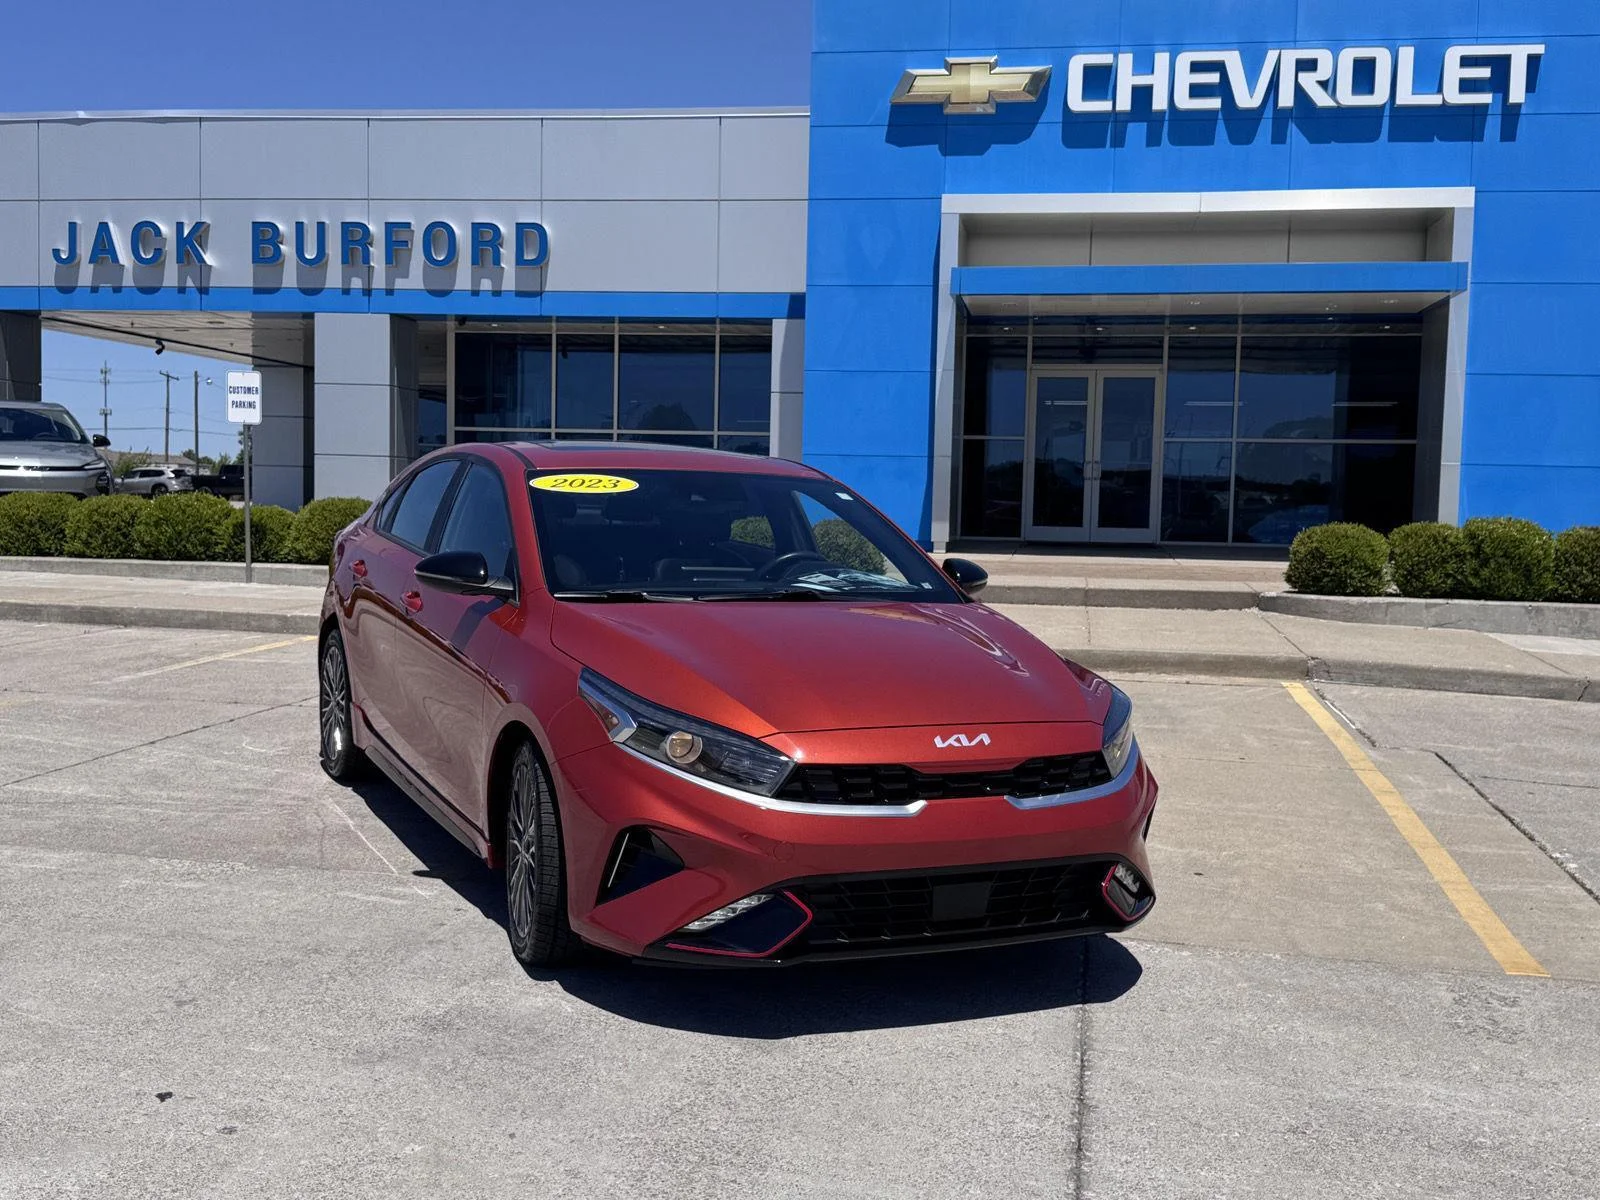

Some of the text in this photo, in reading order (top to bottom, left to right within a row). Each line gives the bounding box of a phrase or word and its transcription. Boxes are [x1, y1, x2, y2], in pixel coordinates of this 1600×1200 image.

[1066, 43, 1546, 113] CHEVROLET
[52, 220, 550, 268] JACK BURFORD
[228, 385, 259, 395] CUSTOMER
[231, 400, 257, 409] PARKING
[549, 475, 622, 491] 2023
